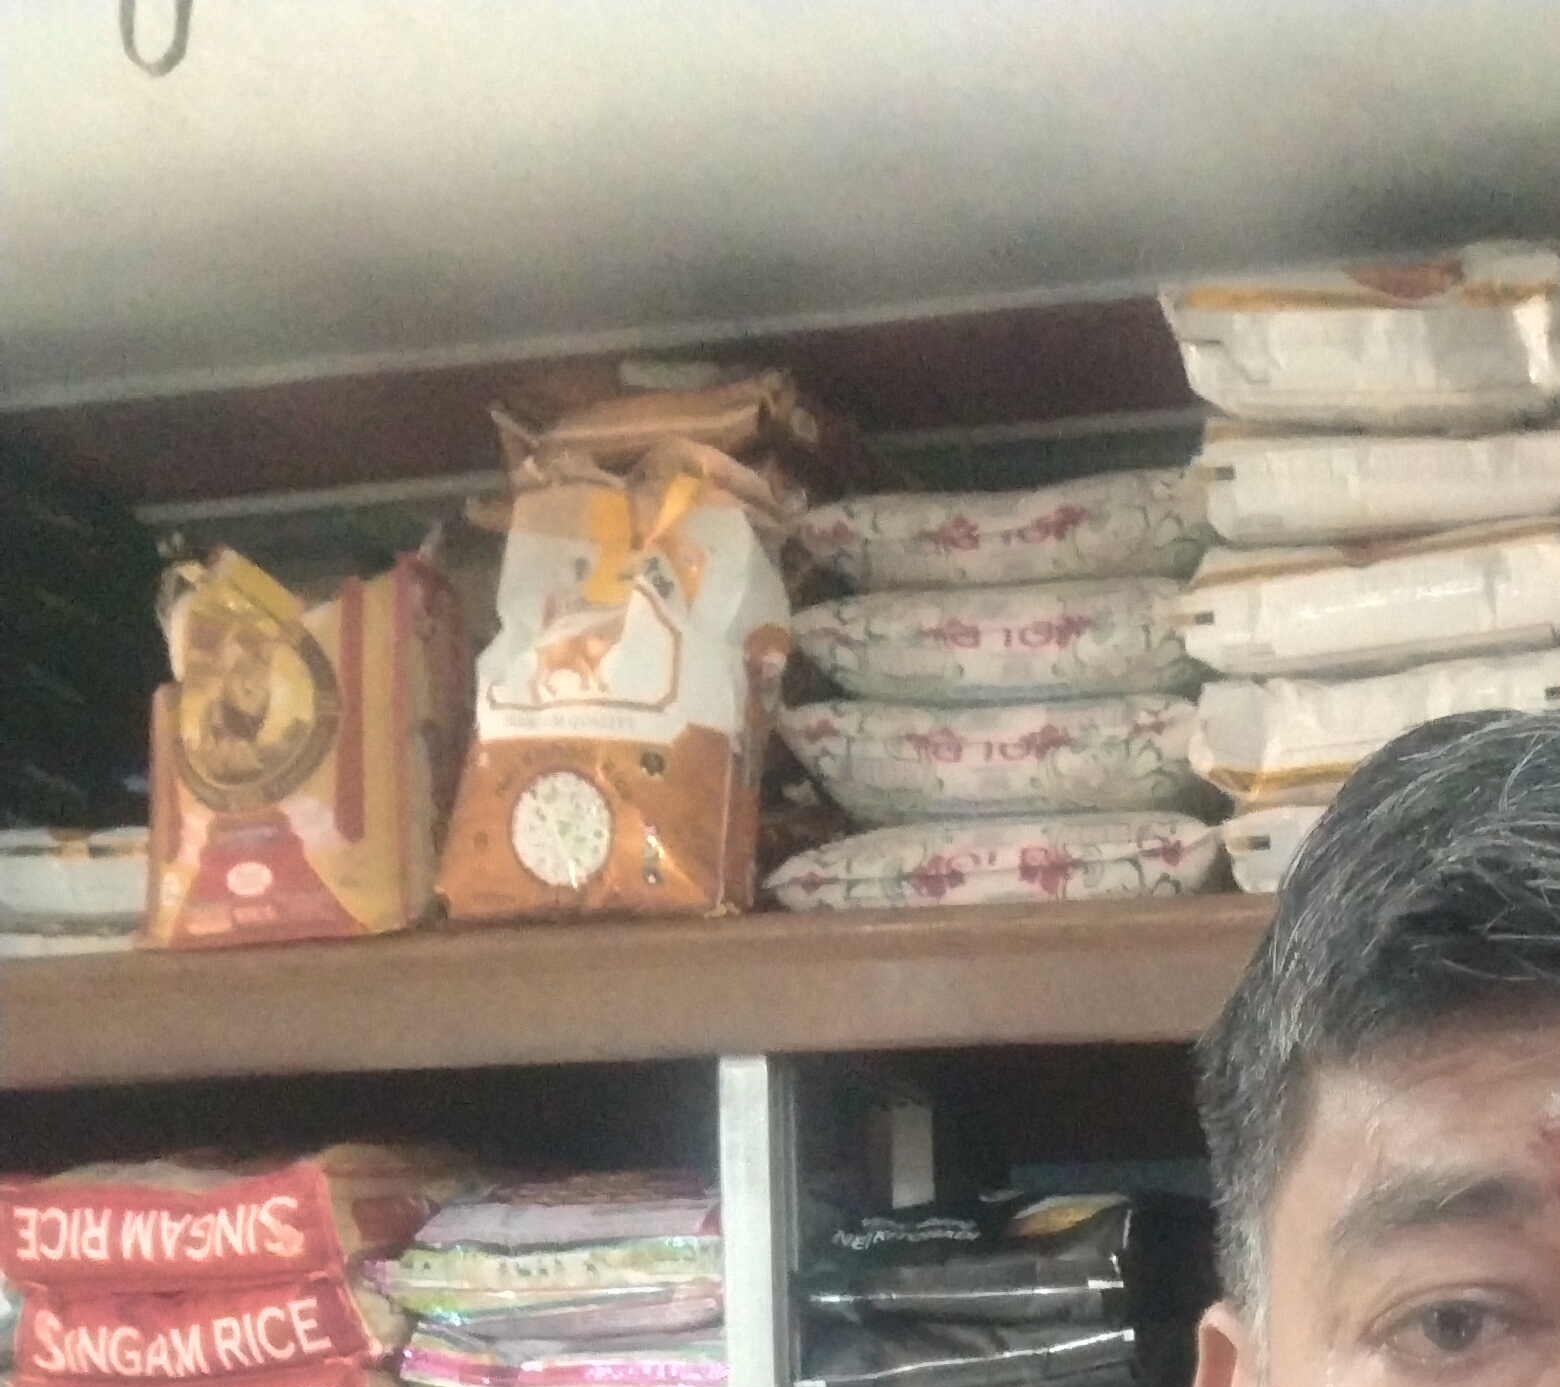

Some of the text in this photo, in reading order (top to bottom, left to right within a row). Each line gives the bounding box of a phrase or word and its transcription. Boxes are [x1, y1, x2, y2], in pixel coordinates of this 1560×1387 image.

[13, 1196, 304, 1261] SINGAM RICE
[33, 1298, 333, 1378] SINGAM RICE
